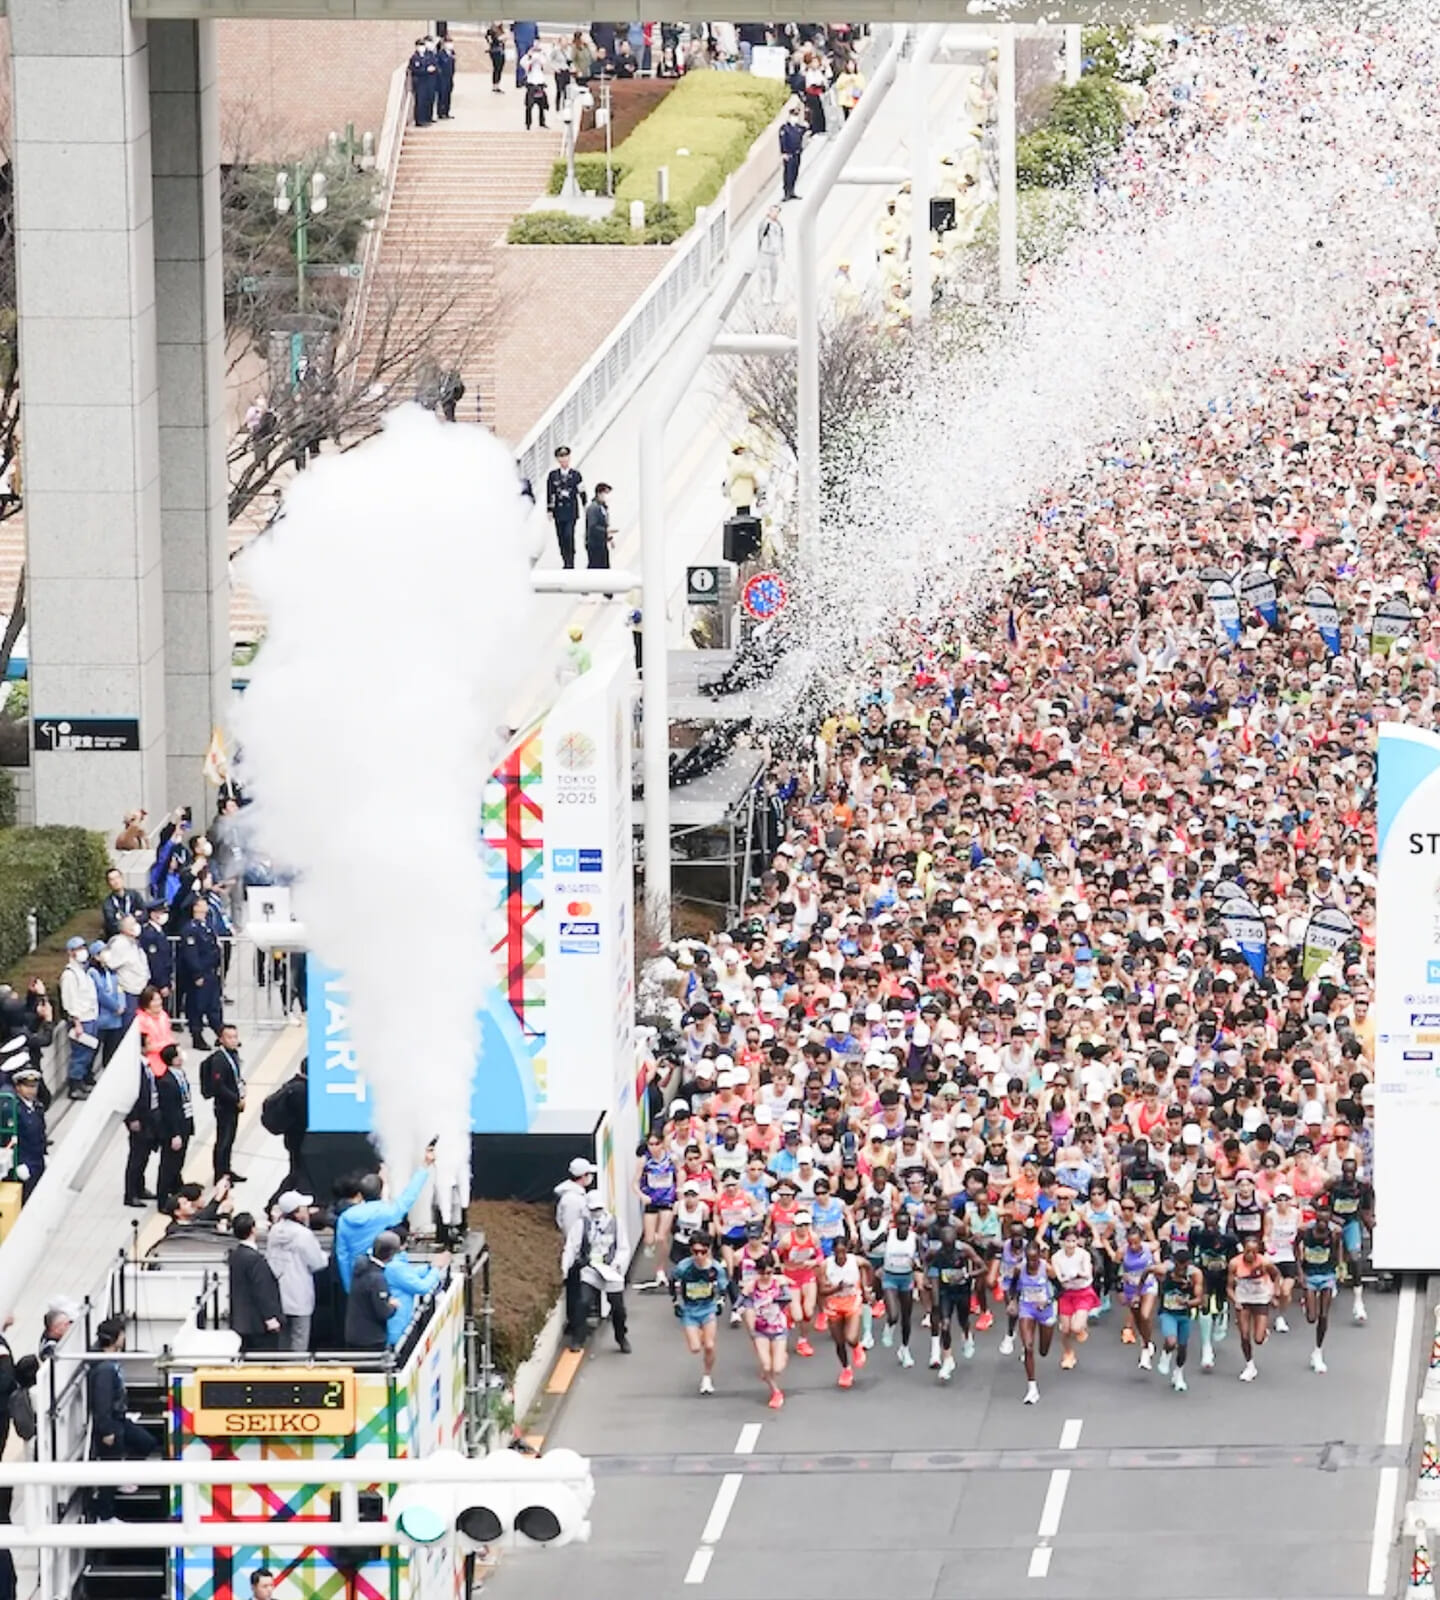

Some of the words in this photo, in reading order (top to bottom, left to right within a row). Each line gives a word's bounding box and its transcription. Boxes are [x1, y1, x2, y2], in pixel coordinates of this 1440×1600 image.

[557, 776, 597, 784] TOKYO
[557, 792, 596, 804] 2025
[1235, 928, 1263, 939] 2:50
[1310, 933, 1337, 947] 2:50
[225, 1413, 321, 1432] SEIKO
